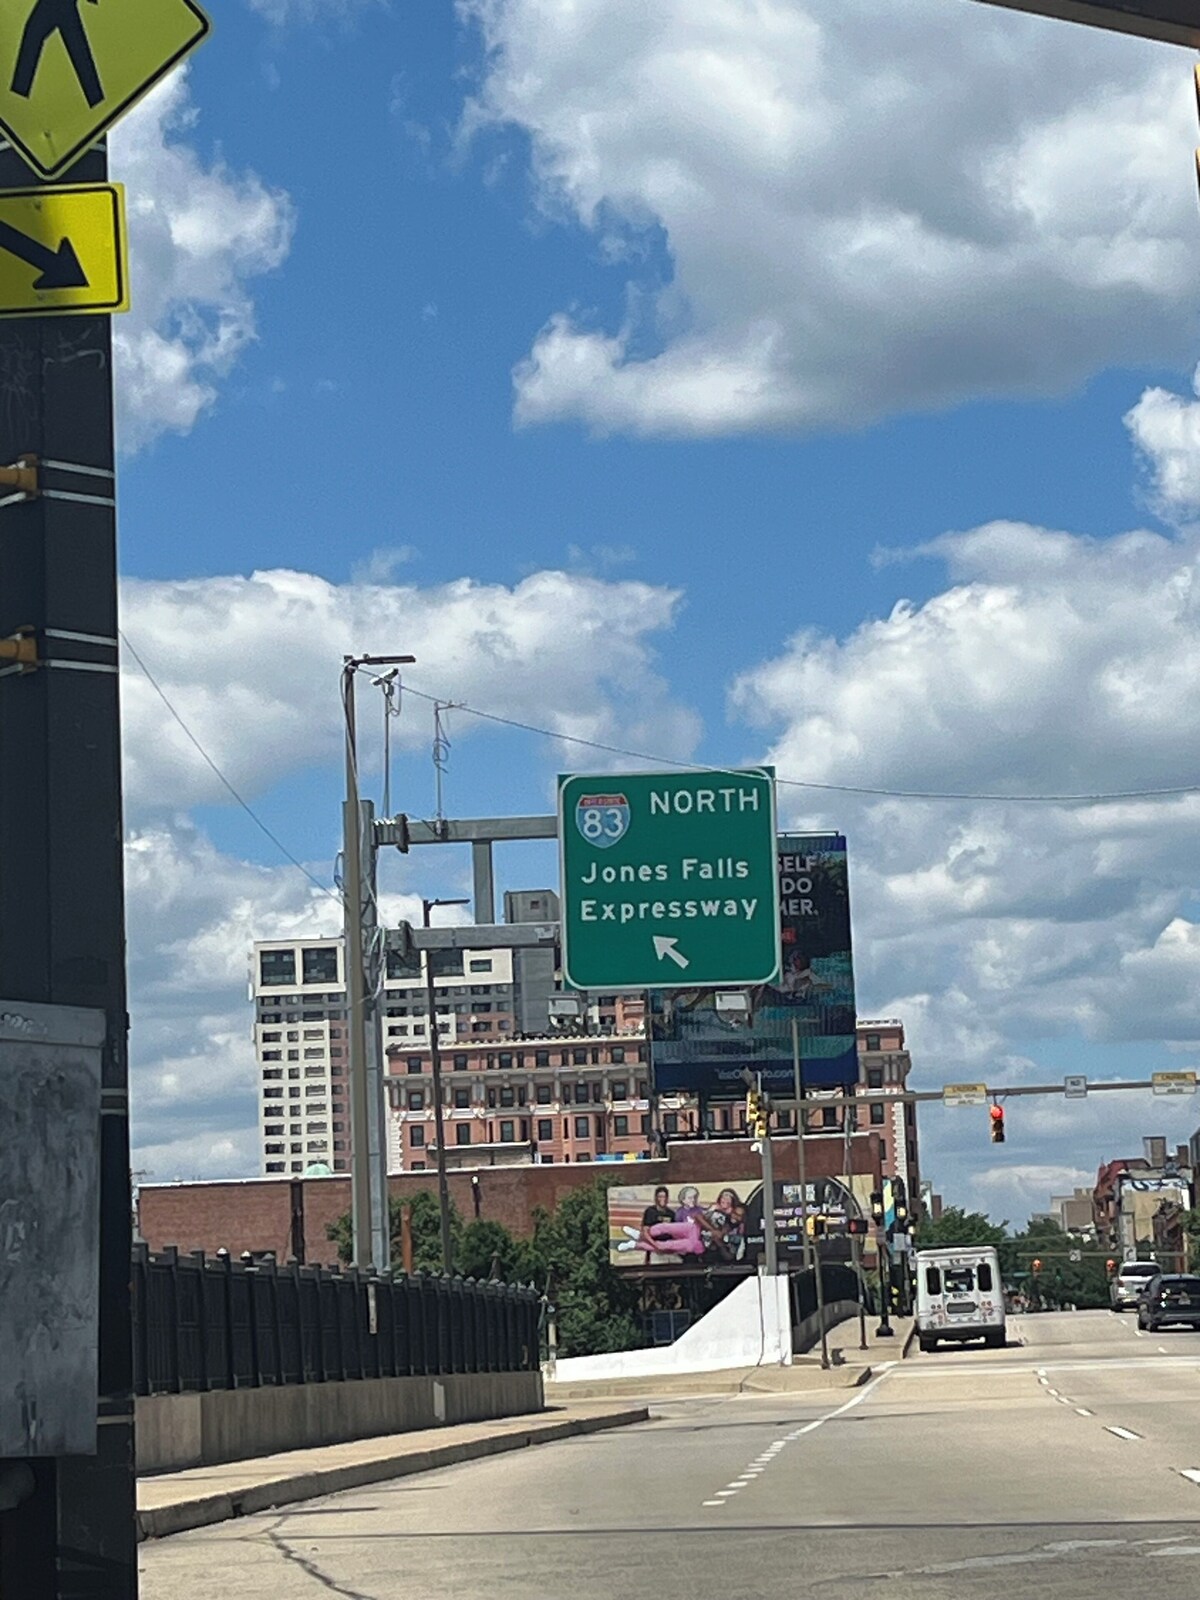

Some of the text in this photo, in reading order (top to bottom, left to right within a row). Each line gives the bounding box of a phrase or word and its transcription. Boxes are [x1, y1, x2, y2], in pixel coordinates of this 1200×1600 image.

[650, 788, 758, 814] NORTH
[583, 809, 623, 838] 83
[581, 858, 749, 884] Jones Falls
[781, 877, 813, 895] DO
[581, 899, 757, 924] Expressway
